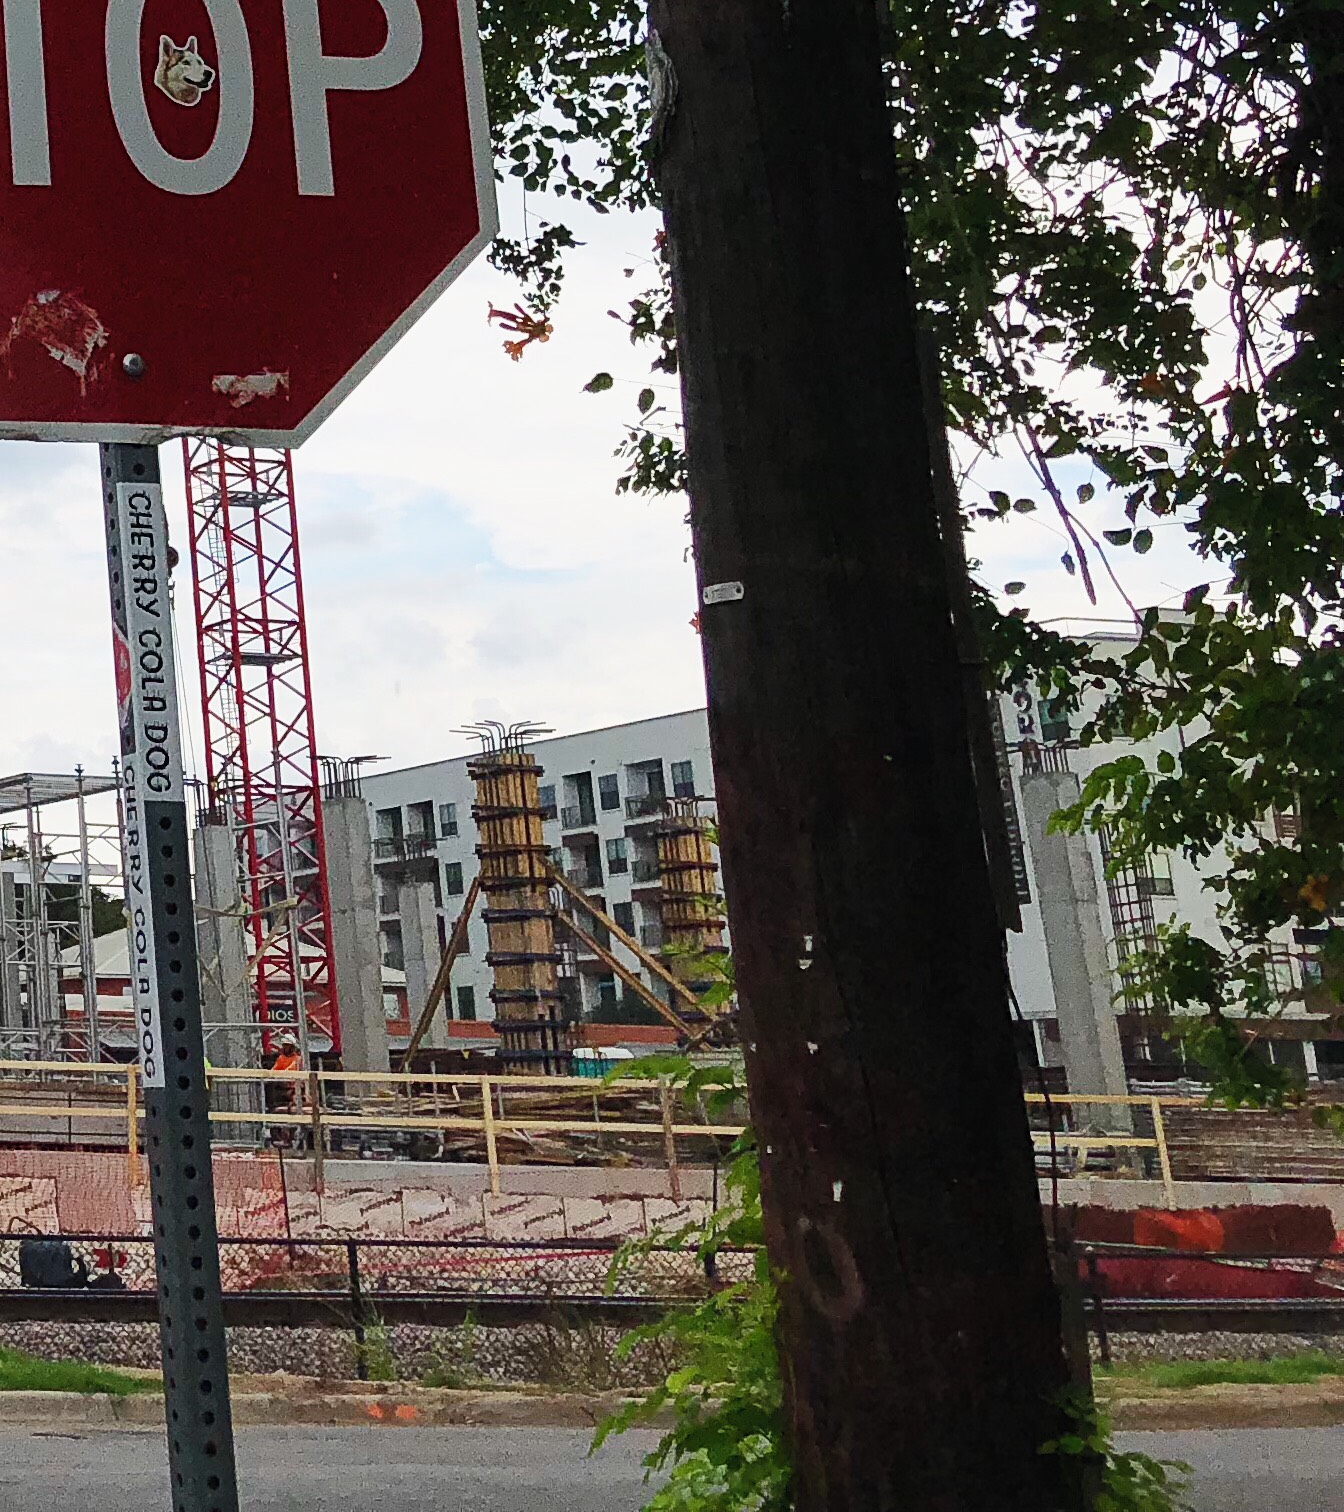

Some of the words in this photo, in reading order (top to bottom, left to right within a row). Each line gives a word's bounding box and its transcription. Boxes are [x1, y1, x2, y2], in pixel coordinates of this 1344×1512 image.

[127, 489, 158, 617] CHERRY
[137, 630, 167, 715] COLA
[146, 720, 173, 793] DOG
[122, 764, 144, 894] CHERRY
[133, 906, 151, 998] COLA
[141, 1006, 157, 1080] DOG
